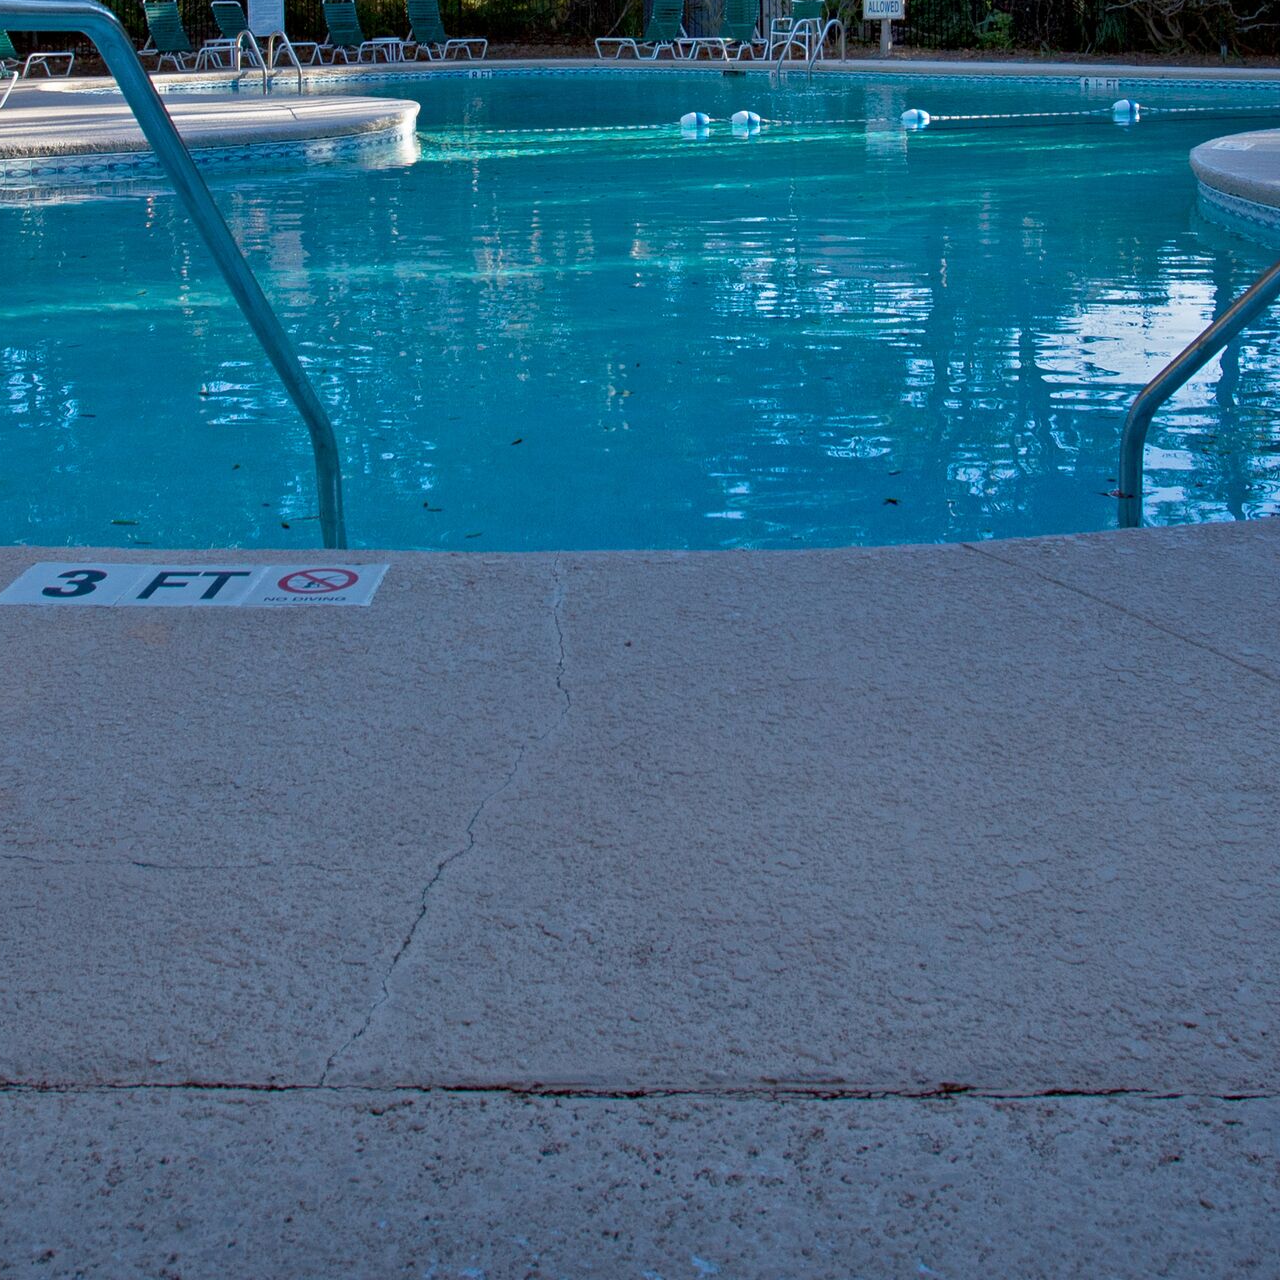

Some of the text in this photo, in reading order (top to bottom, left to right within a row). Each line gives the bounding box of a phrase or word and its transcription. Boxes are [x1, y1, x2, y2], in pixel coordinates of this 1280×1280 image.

[867, 0, 900, 13] ALLOWED
[1106, 79, 1118, 88] FT
[42, 569, 252, 600] 3 FT
